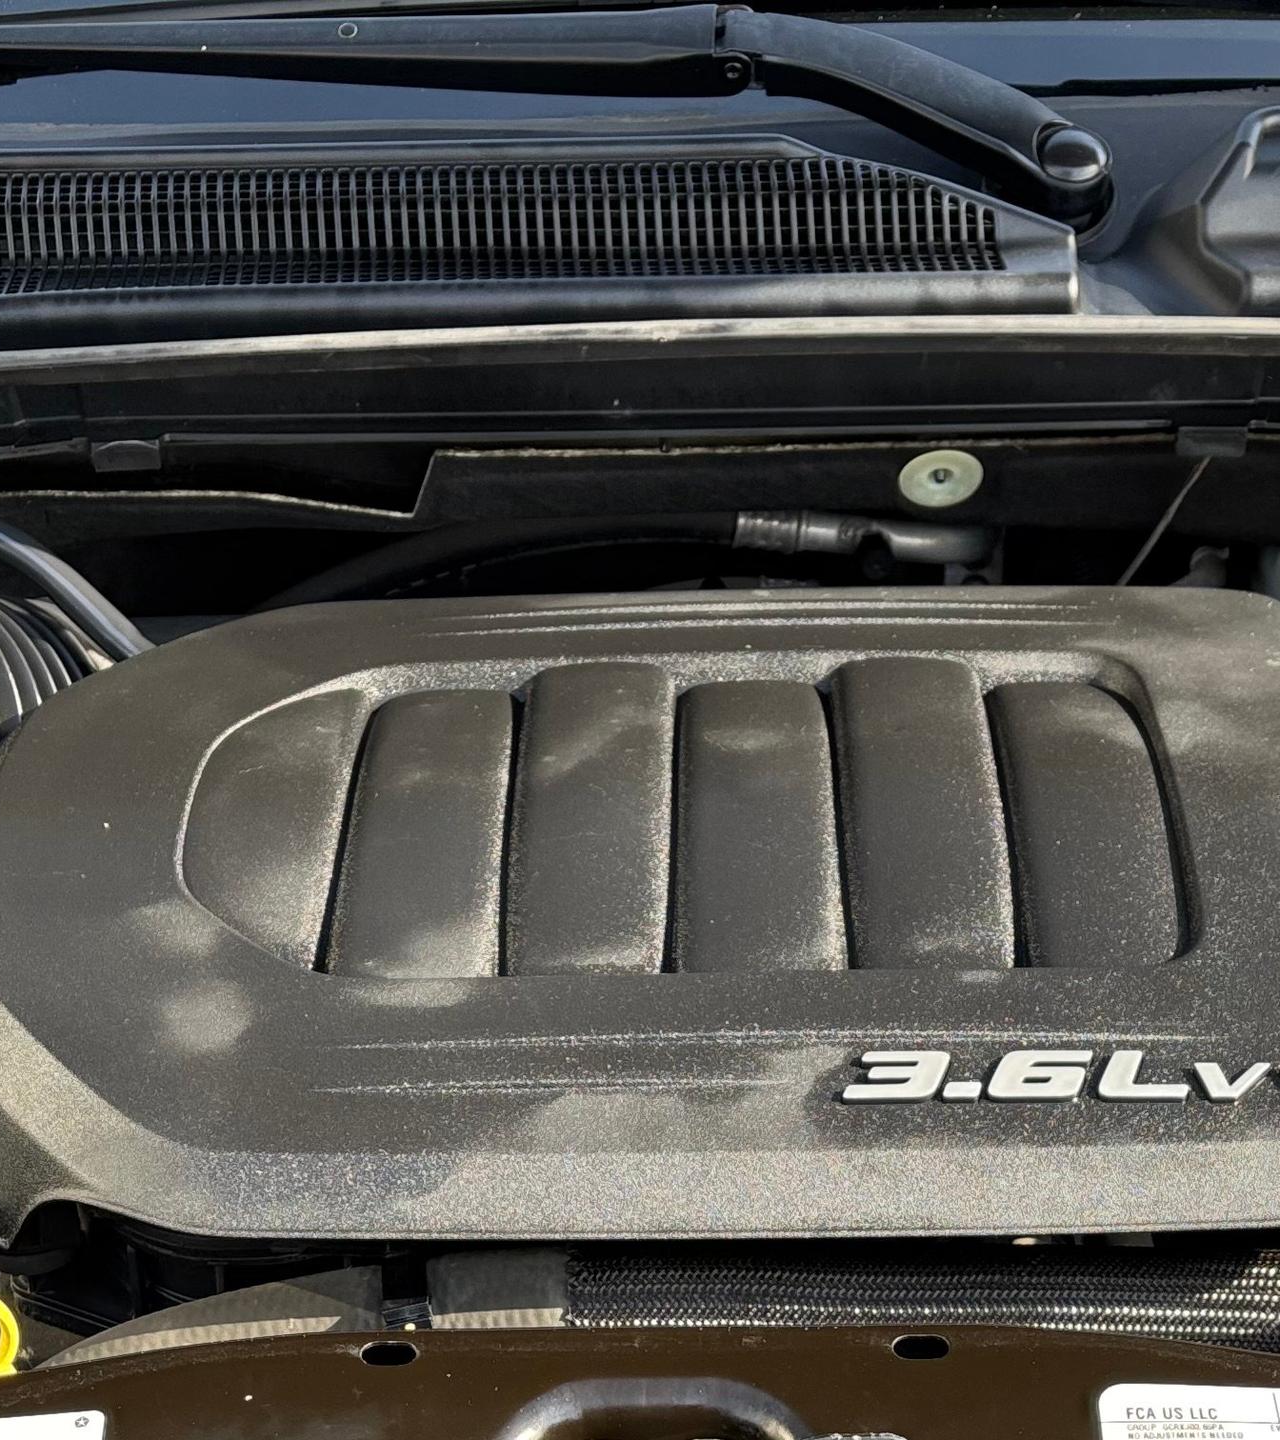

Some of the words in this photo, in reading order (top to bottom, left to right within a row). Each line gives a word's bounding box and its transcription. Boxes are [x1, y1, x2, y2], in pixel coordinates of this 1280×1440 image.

[1125, 1407, 1157, 1420] FCA
[1162, 1407, 1184, 1420] US
[1189, 1407, 1219, 1420] LLC
